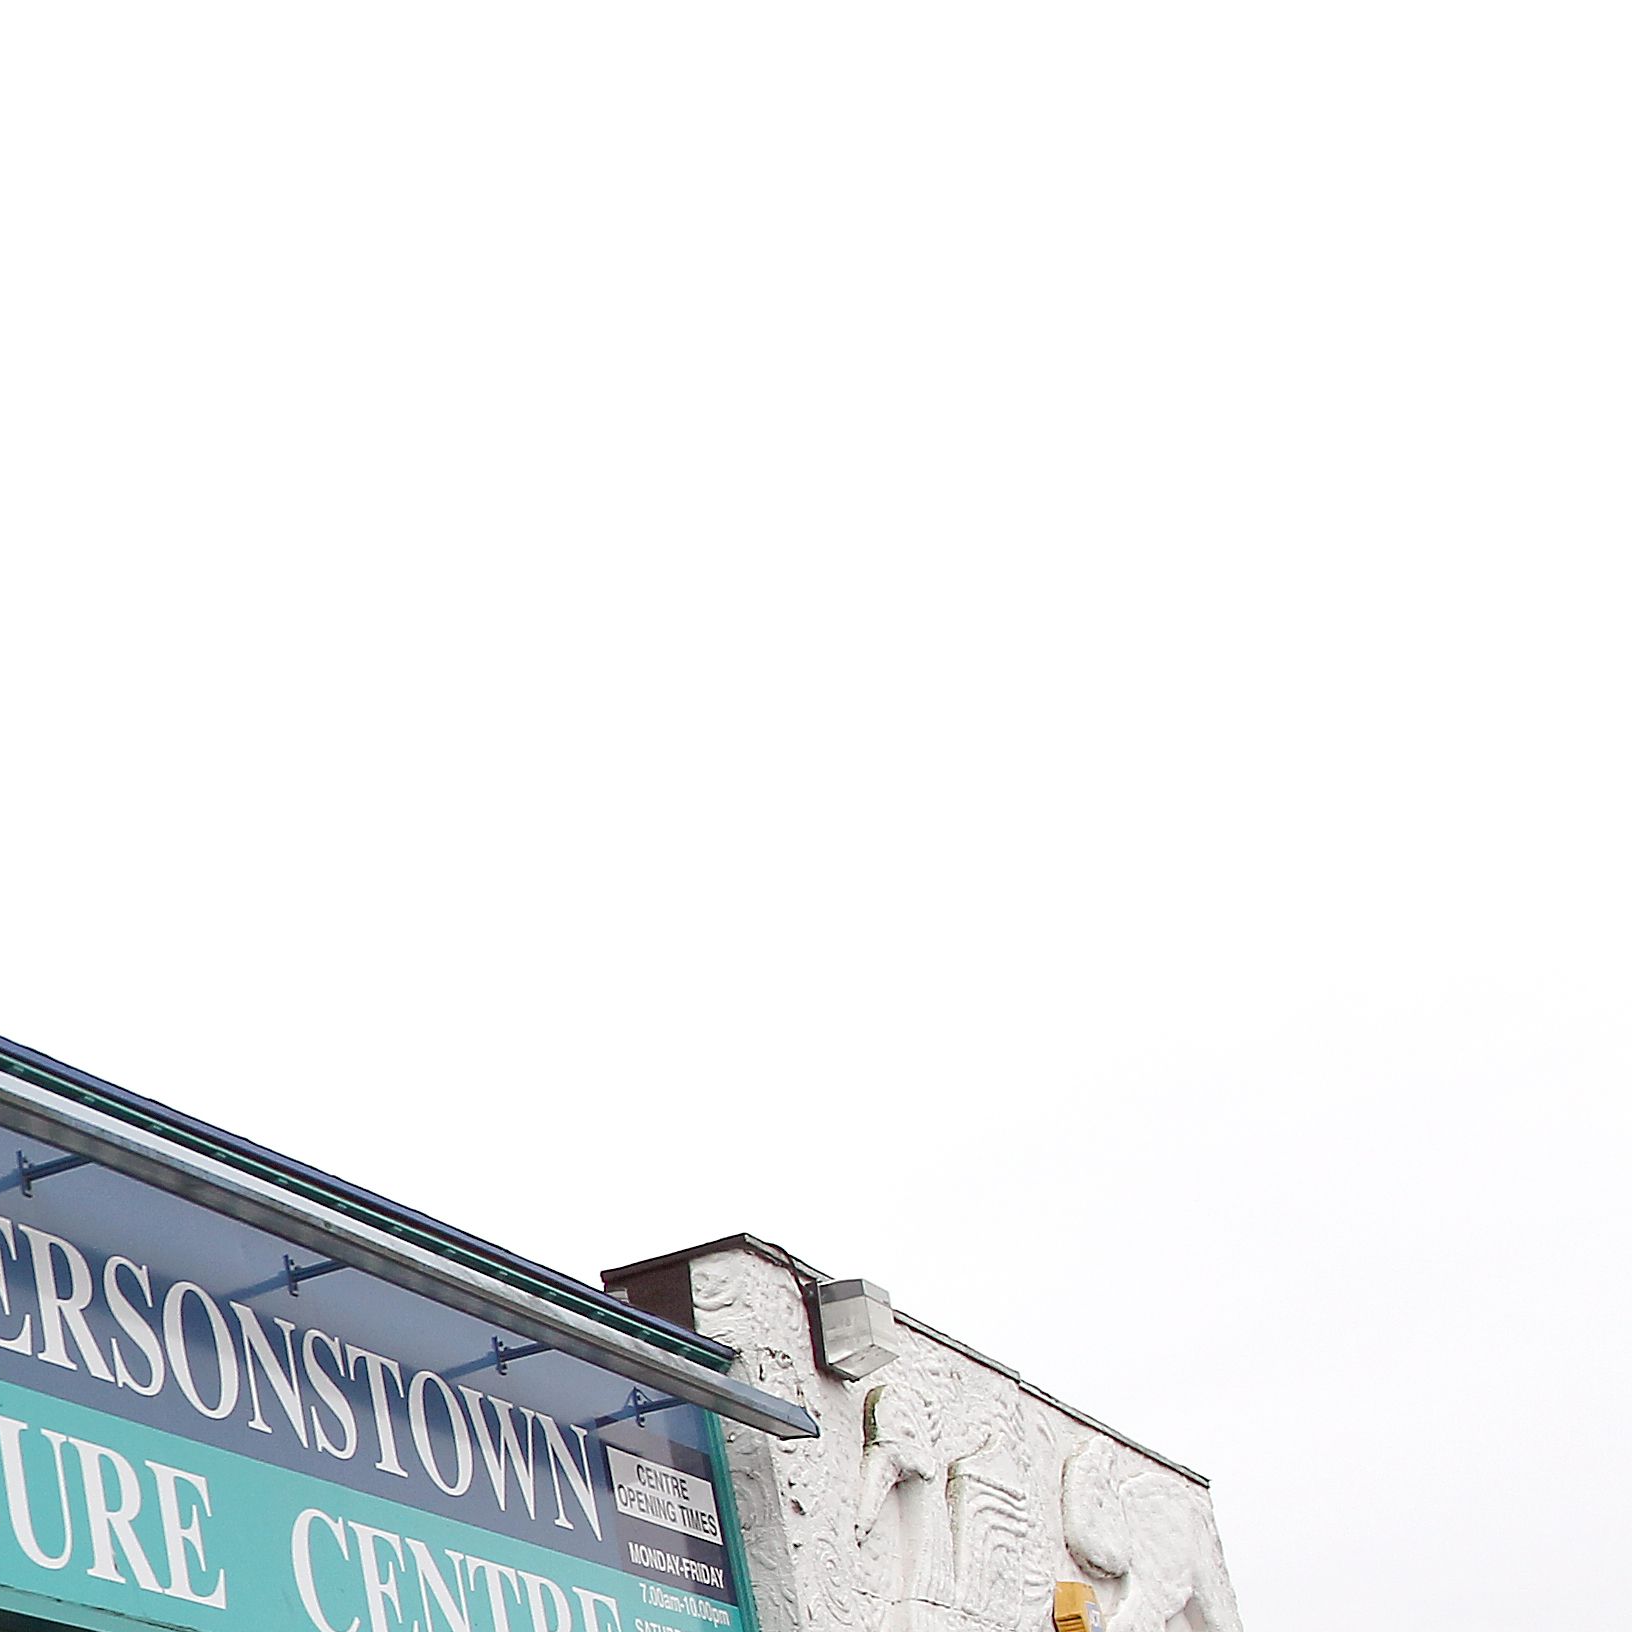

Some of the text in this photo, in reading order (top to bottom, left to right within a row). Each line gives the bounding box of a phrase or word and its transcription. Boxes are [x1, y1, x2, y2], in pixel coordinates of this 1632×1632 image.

[636, 1463, 690, 1501] CENTRE
[617, 1484, 718, 1537] OPENING TIMES
[628, 1541, 724, 1589] MONDAY-FRIDAY
[639, 1582, 731, 1629] 7.00am-10.00pm
